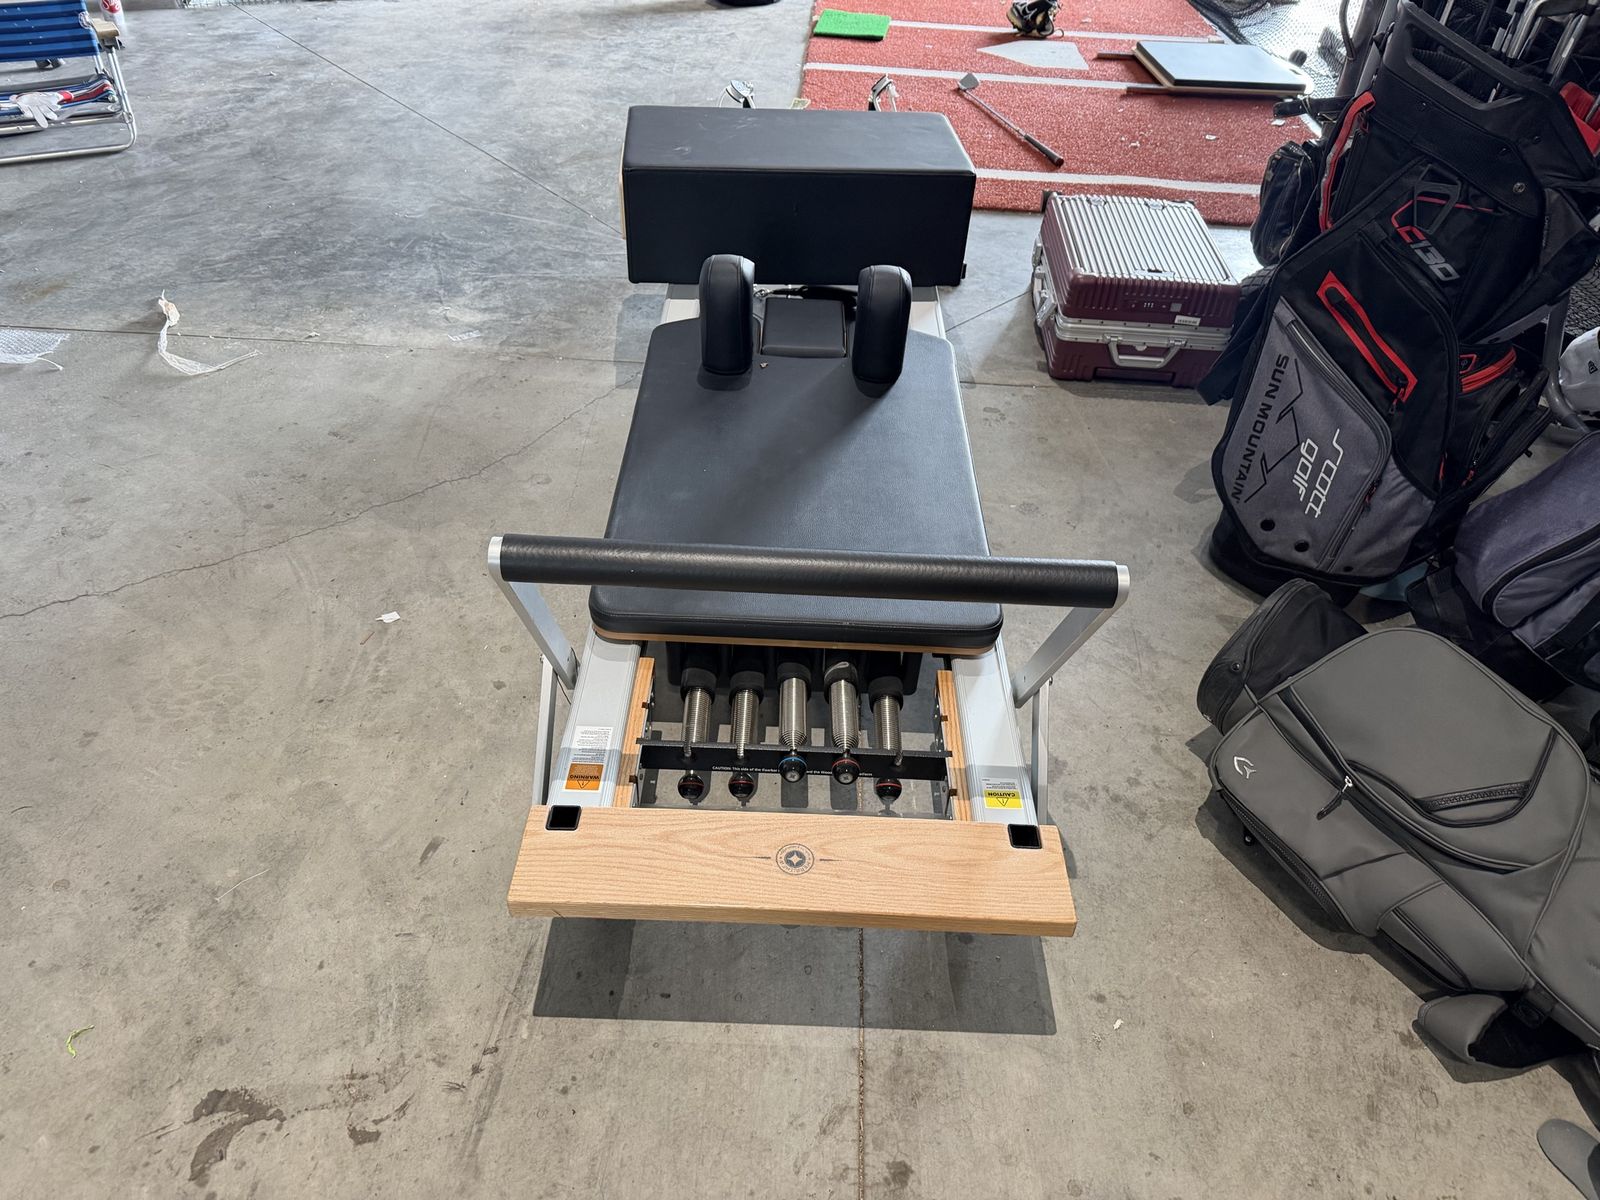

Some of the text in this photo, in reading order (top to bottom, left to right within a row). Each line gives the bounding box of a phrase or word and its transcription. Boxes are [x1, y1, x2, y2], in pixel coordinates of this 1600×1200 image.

[1396, 225, 1461, 282] C130
[1230, 353, 1290, 502] SUN MOUNTAIN
[1292, 438, 1319, 502] golf
[1304, 427, 1344, 519] scott
